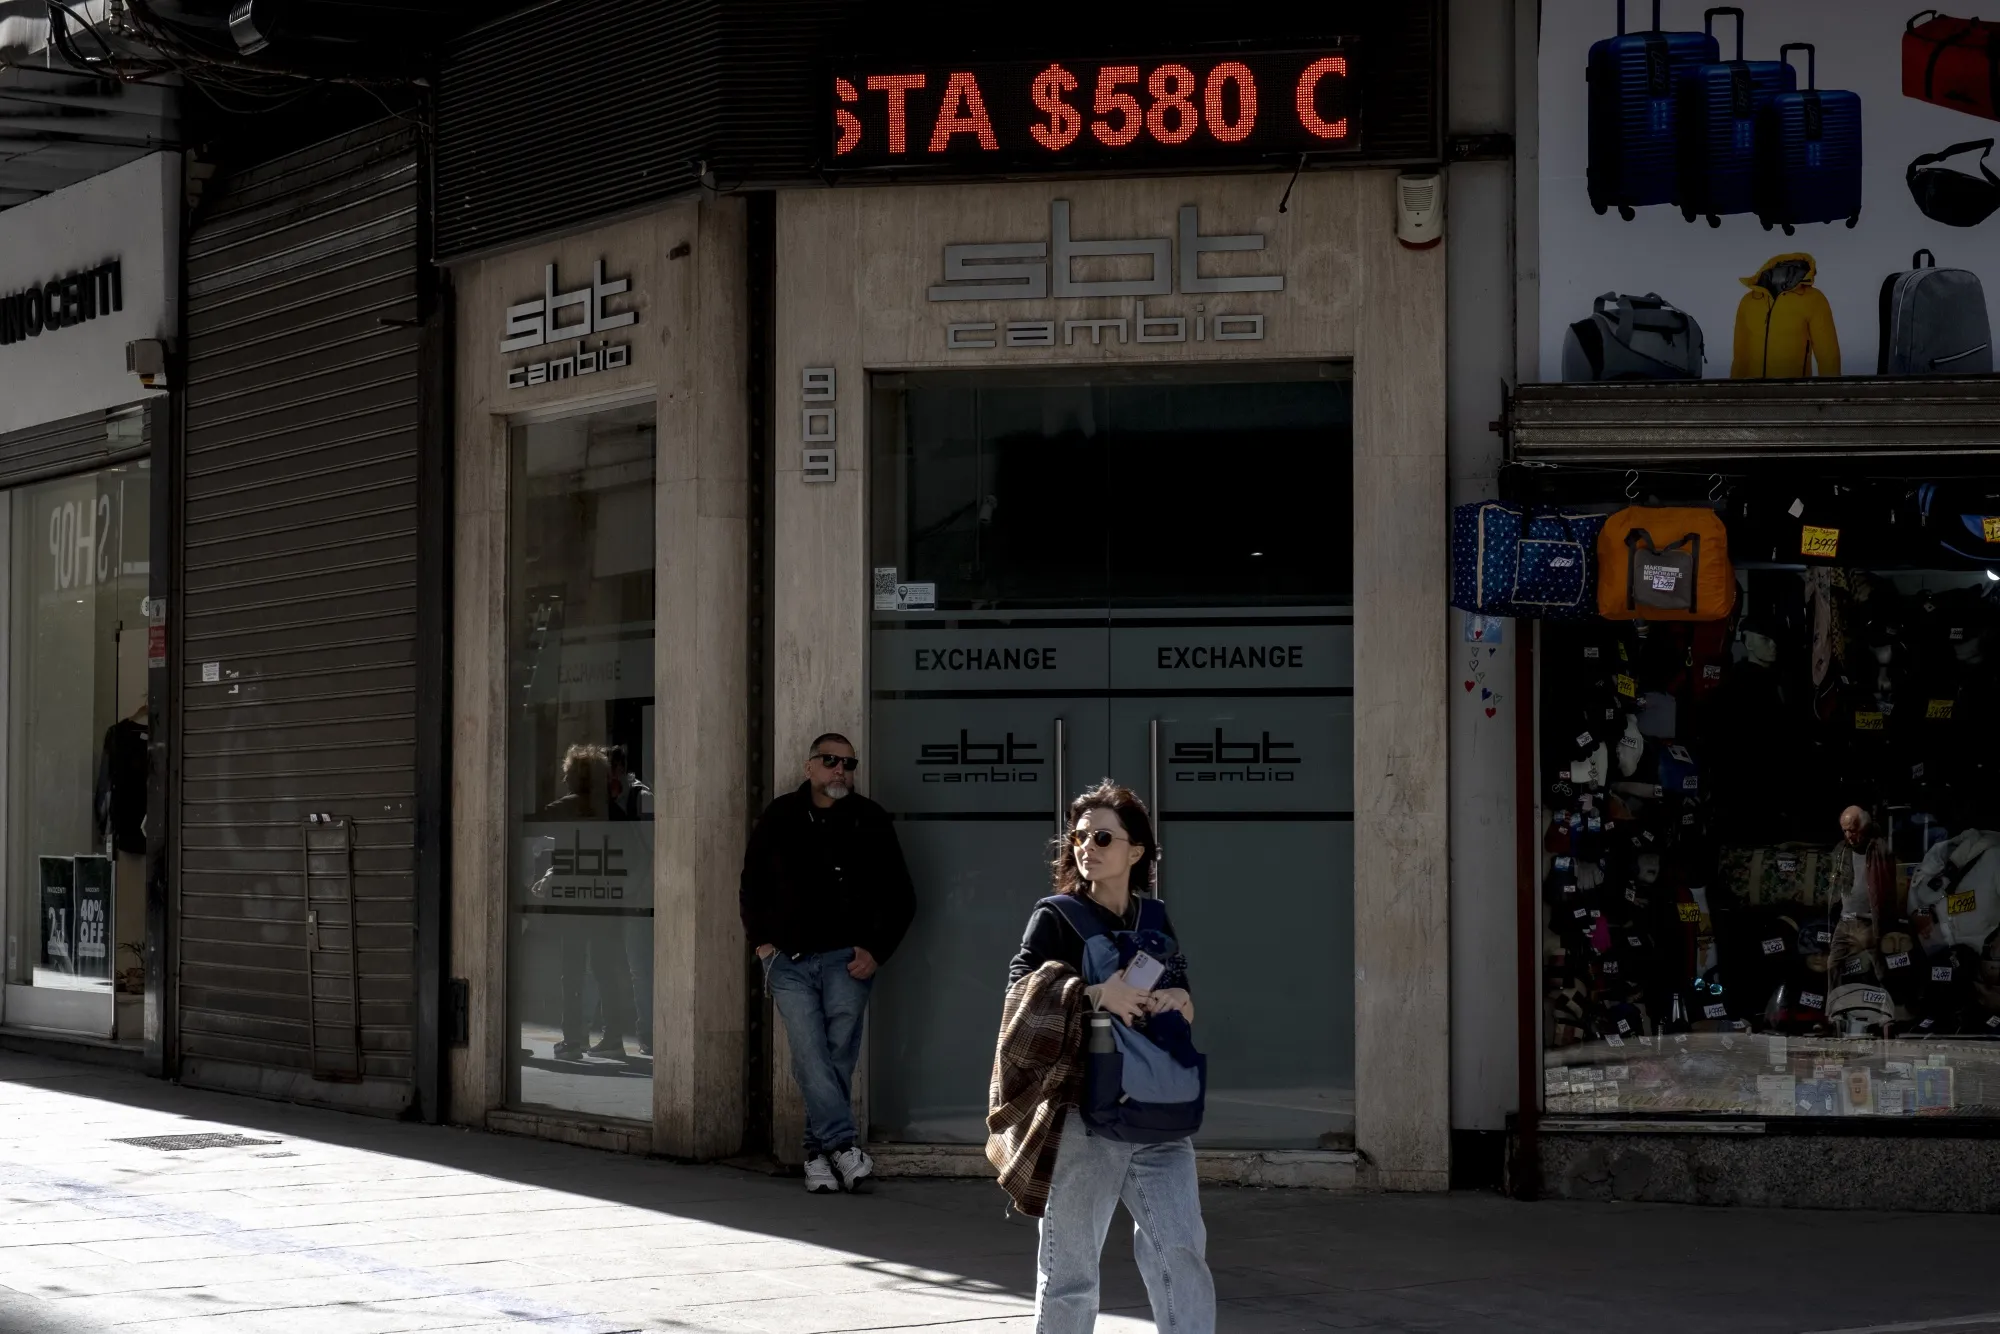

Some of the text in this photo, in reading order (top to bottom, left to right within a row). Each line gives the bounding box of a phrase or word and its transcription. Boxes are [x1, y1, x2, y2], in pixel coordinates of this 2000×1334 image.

[1029, 61, 1258, 151] $580
[928, 200, 1284, 302] sbt
[500, 260, 636, 353] sbt
[947, 299, 1264, 349] cambio
[506, 341, 629, 389] cambio
[802, 367, 836, 483] 909
[557, 659, 621, 685] EXCHANGE
[915, 647, 1057, 671] EXCHANGE
[1157, 646, 1303, 669] EXCHANGE
[916, 728, 1044, 765] sbt
[1169, 727, 1301, 763] sbt
[922, 765, 1038, 783] cambio
[1175, 765, 1295, 782] cambio
[551, 829, 628, 876] sbt
[551, 878, 623, 900] cambio
[80, 899, 104, 921] 40%
[80, 922, 104, 944] OFF
